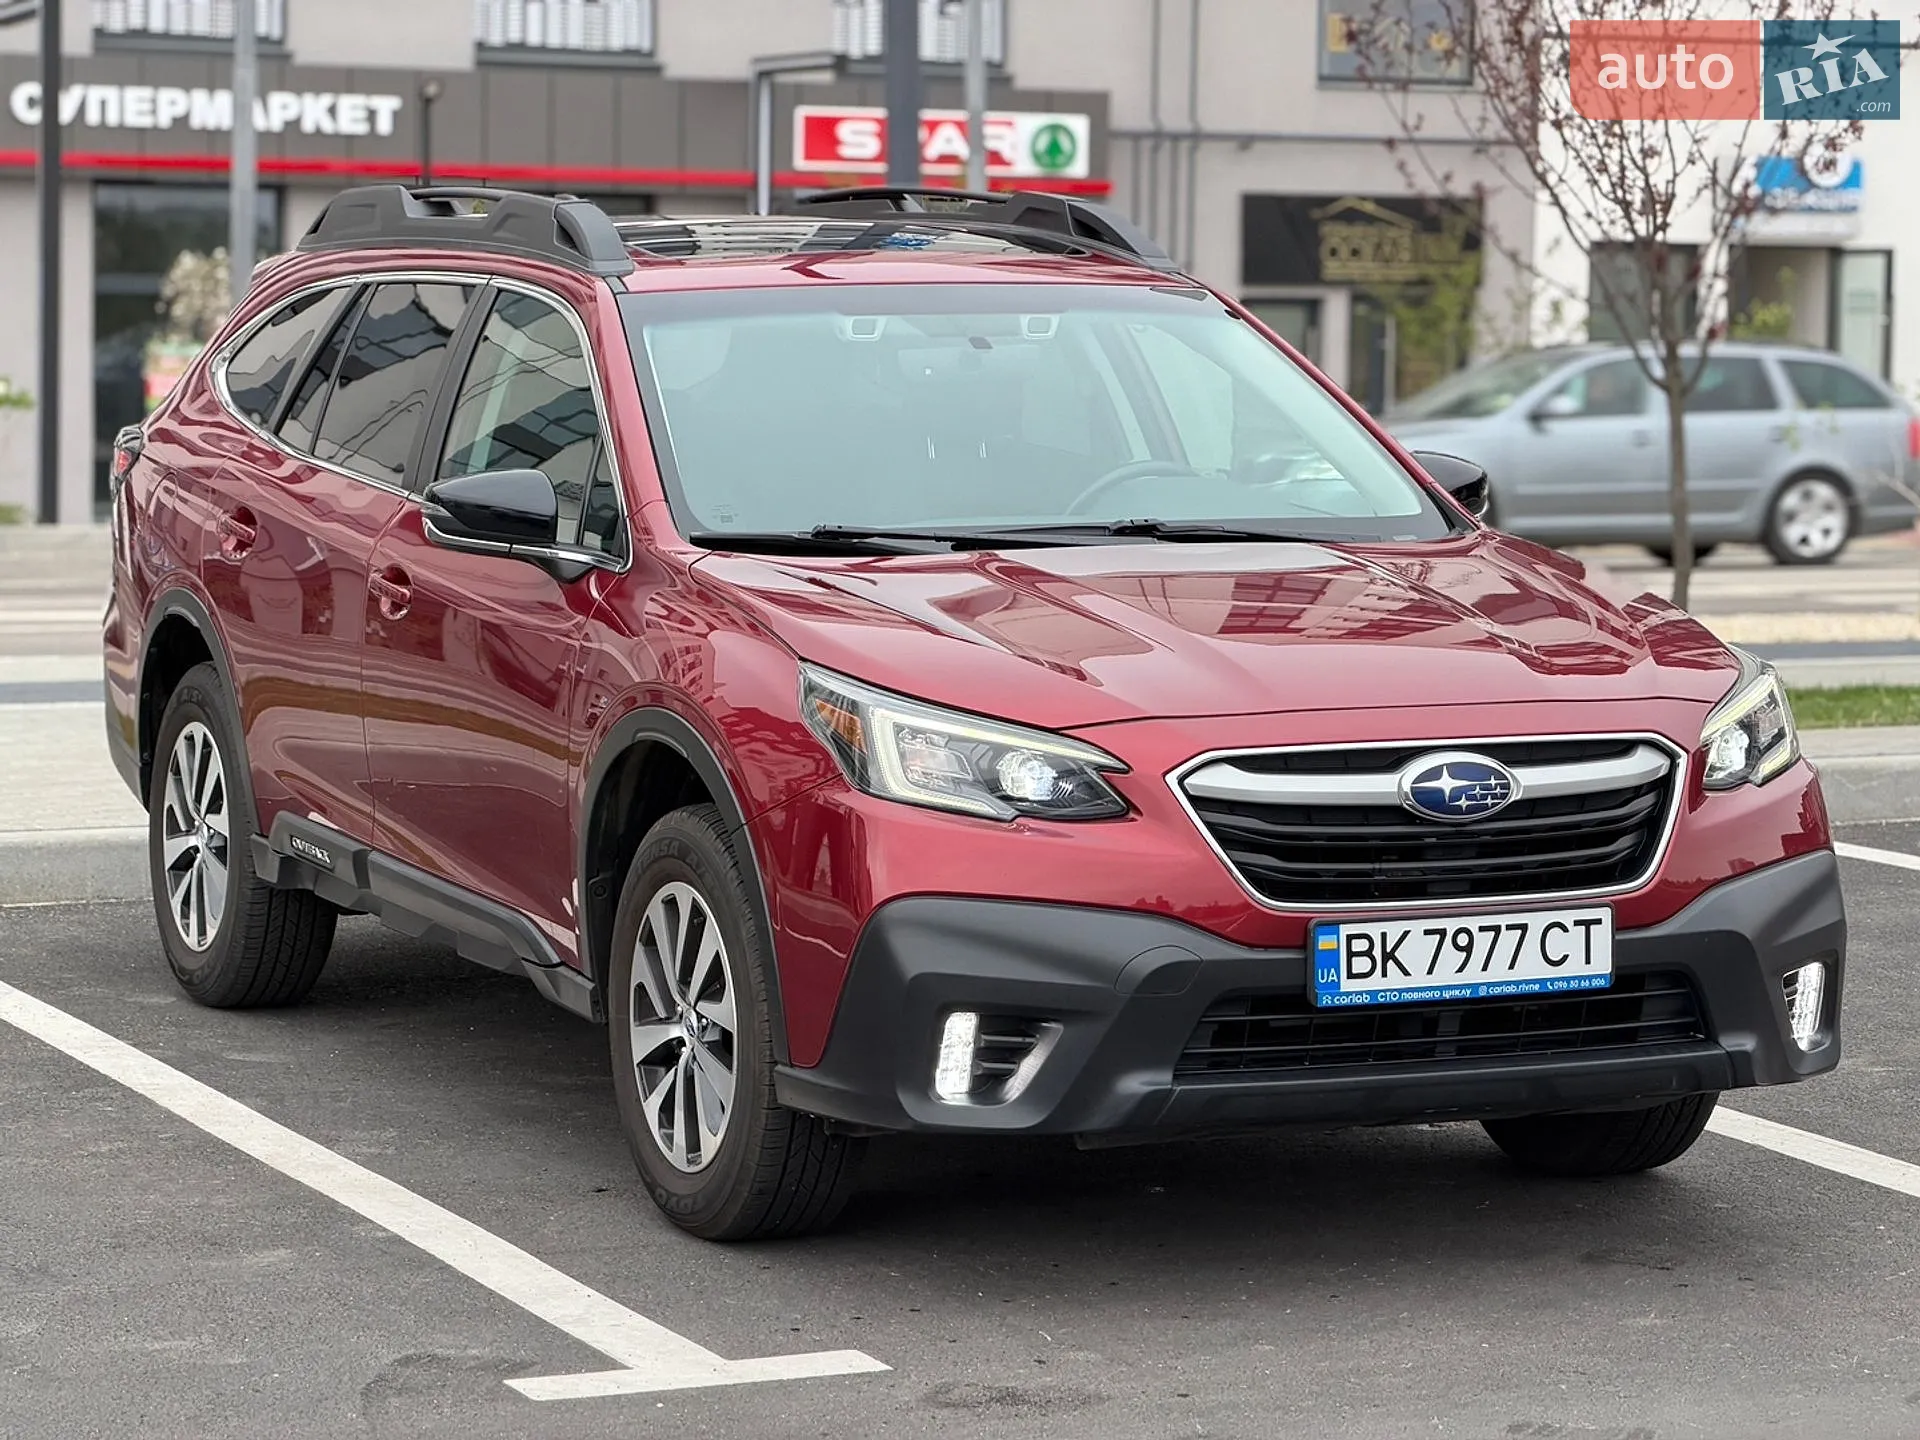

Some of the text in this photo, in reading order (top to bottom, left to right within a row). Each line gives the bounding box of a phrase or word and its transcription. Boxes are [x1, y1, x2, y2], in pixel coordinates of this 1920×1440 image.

[834, 117, 1017, 167] SAR
[1345, 917, 1603, 980] BK 7977 CT
[1318, 968, 1339, 984] UA
[1333, 992, 1371, 1004] carlab
[1401, 990, 1441, 1000] повного
